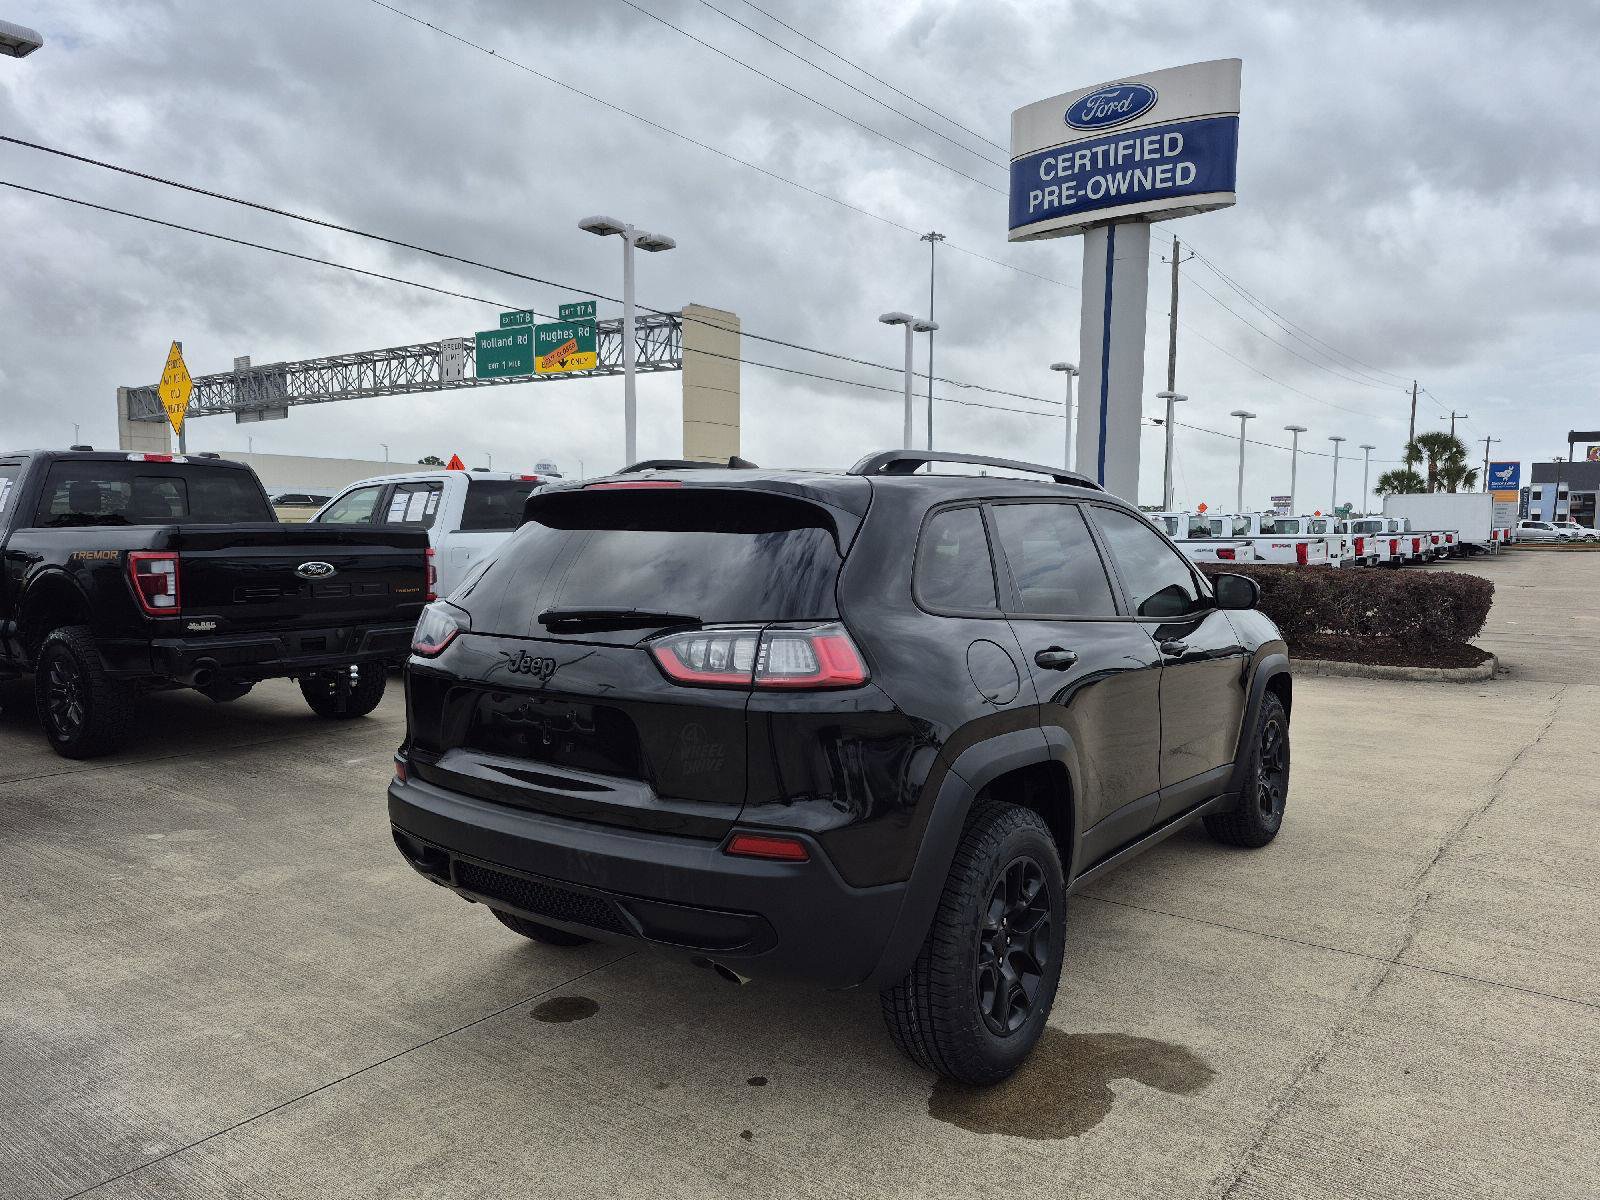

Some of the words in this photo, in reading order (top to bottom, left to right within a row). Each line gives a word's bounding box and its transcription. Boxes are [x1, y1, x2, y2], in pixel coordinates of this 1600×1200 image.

[1081, 89, 1132, 121] Ford
[1039, 132, 1184, 181] CERTIFIED
[1029, 162, 1197, 214] PRE-OWNED
[481, 335, 513, 349] Holland
[517, 334, 528, 345] Rd
[540, 328, 574, 343] Hughes
[578, 326, 590, 337] Rd
[72, 550, 119, 560] TREMOR
[307, 564, 326, 575] Ford
[507, 649, 557, 681] Jeep
